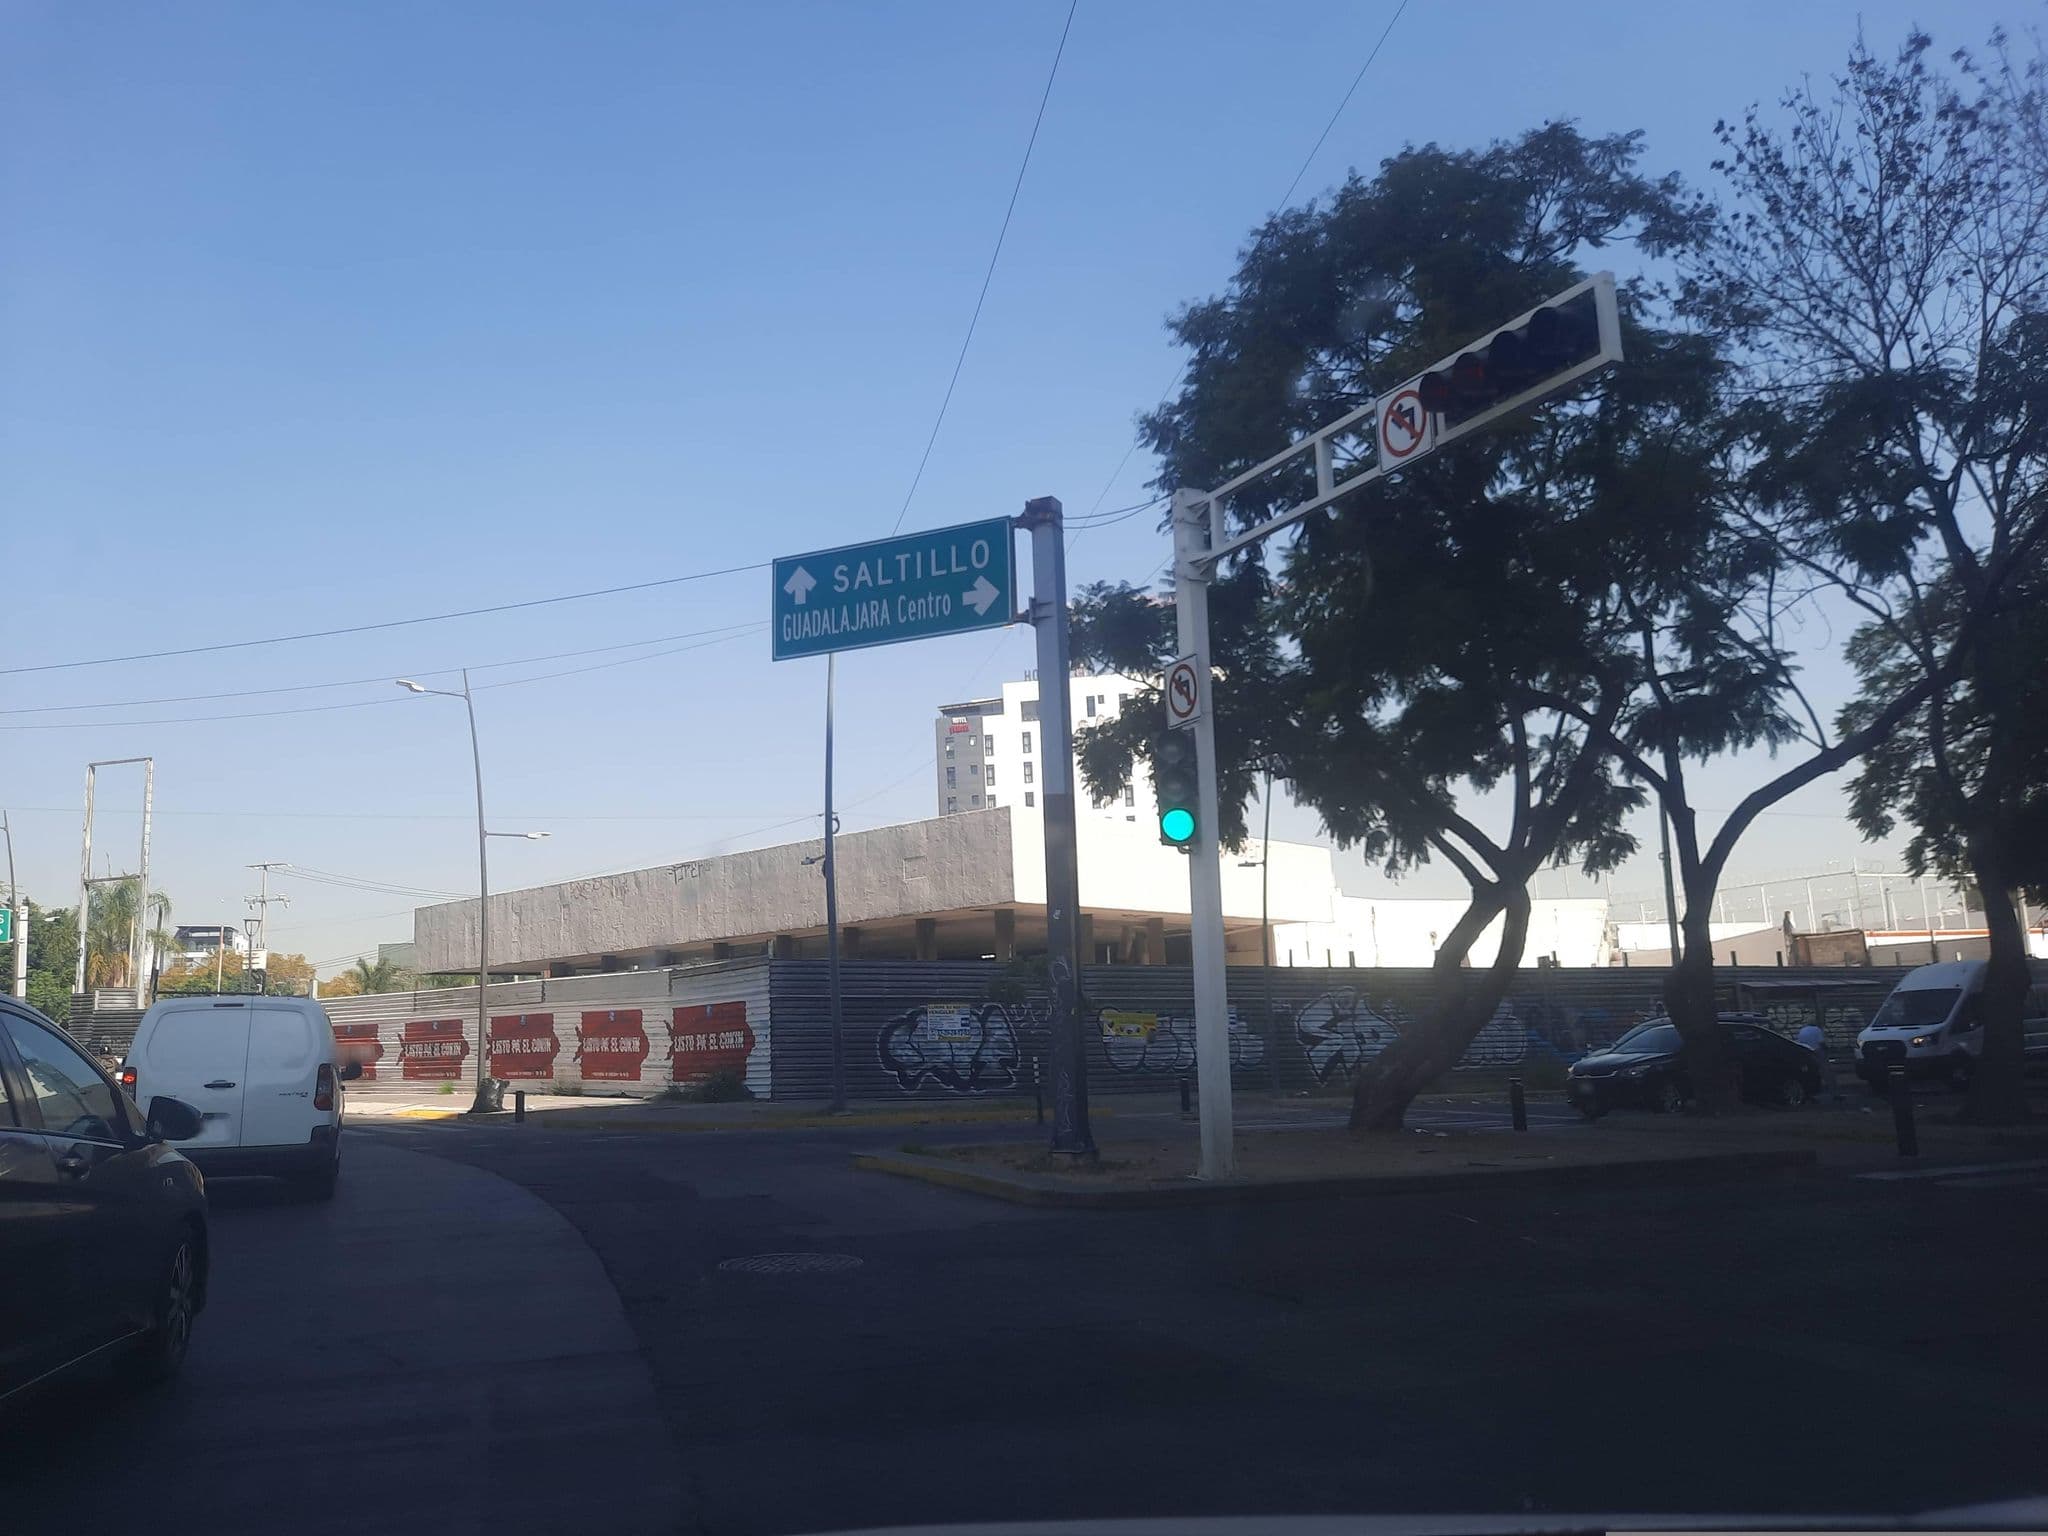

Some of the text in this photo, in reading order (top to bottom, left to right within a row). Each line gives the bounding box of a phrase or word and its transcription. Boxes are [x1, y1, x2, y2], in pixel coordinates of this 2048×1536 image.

[833, 539, 990, 593] SALTILLO
[783, 592, 952, 642] GUADALAJARA Centro
[674, 1034, 694, 1053] LISTO
[709, 1032, 719, 1051] EL
